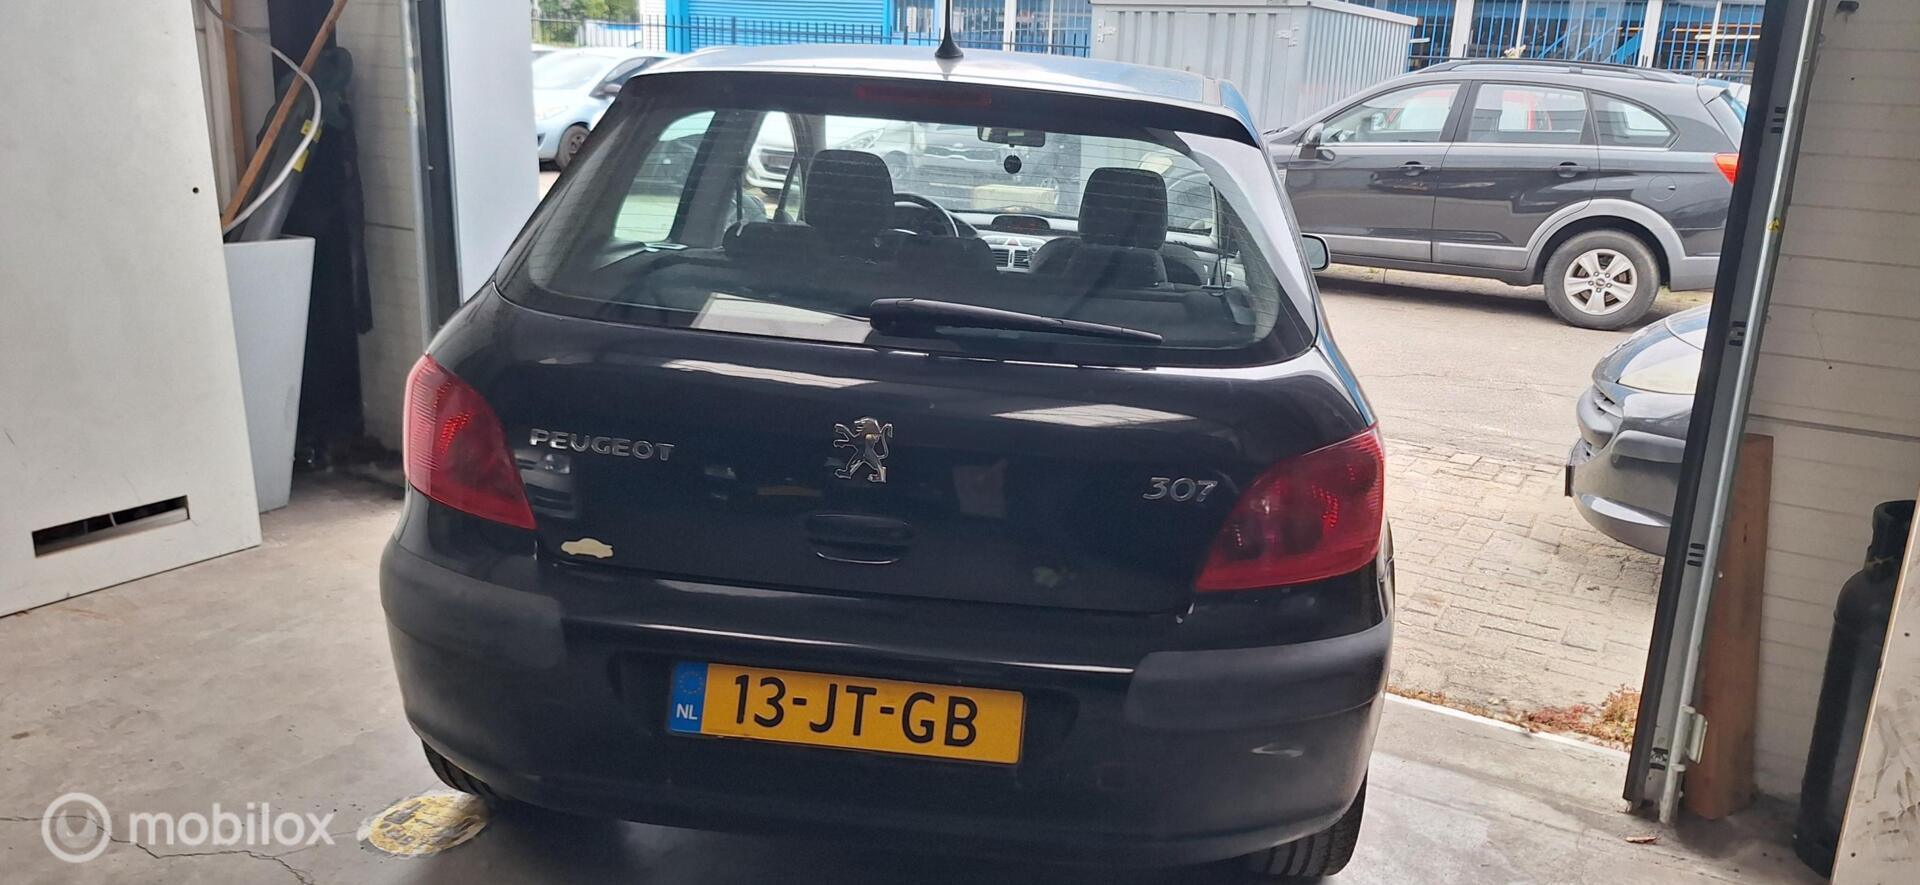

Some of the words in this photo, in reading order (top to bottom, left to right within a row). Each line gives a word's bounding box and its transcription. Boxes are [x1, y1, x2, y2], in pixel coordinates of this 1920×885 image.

[529, 428, 675, 461] PEUGEOT
[1142, 476, 1218, 502] 307
[676, 703, 698, 720] NL
[735, 674, 978, 747] 13-JT-GB
